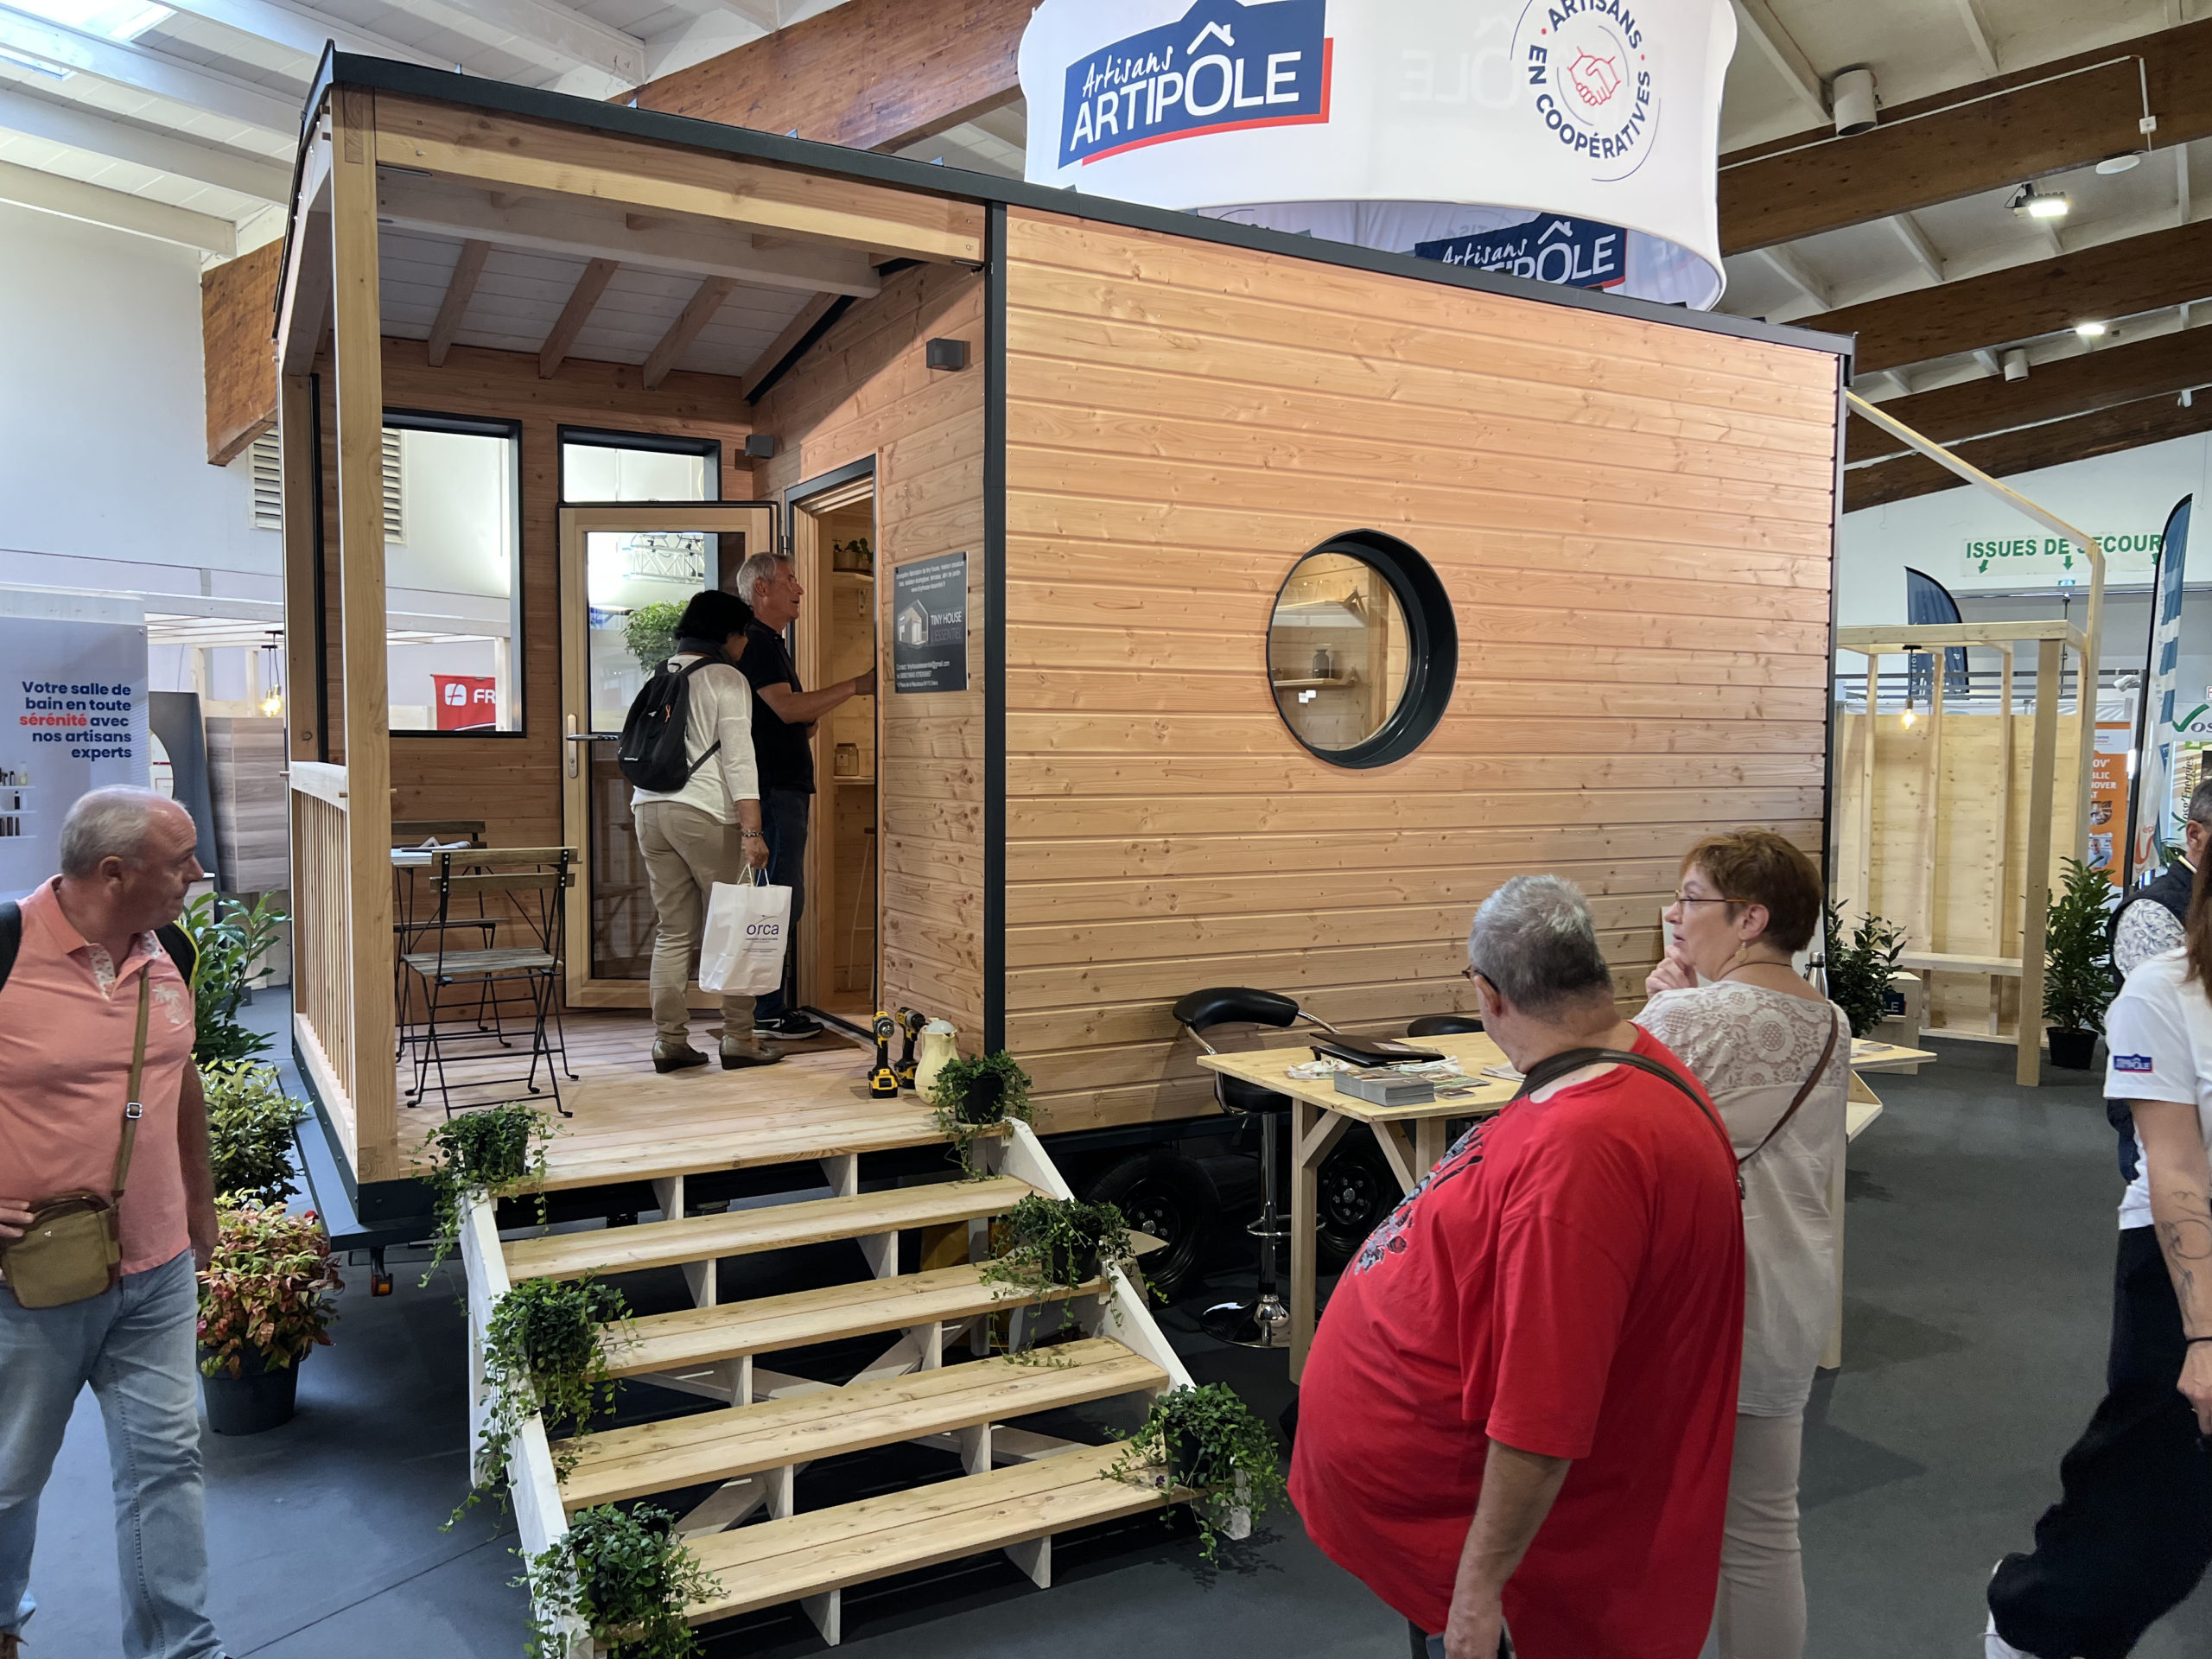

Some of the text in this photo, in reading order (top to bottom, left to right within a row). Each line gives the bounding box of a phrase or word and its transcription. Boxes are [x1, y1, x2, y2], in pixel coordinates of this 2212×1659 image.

[1082, 46, 1173, 98] Artisans
[1529, 45, 1548, 85] EN
[1070, 22, 1302, 151] ARTIPÔLE
[1535, 71, 1650, 159] COOPÉRATIVES
[1442, 238, 1529, 266] Artisans
[1966, 539, 2037, 558] ISSUES
[2044, 538, 2069, 555] DE
[931, 611, 962, 626] TINY HOUSE
[22, 681, 131, 696] Votre salle de
[25, 696, 131, 711] bain en toute
[474, 689, 496, 704] FR
[19, 712, 130, 727] sérénité avec
[32, 729, 131, 742] nos artisans
[71, 747, 132, 761] experts
[747, 924, 779, 936] orca
